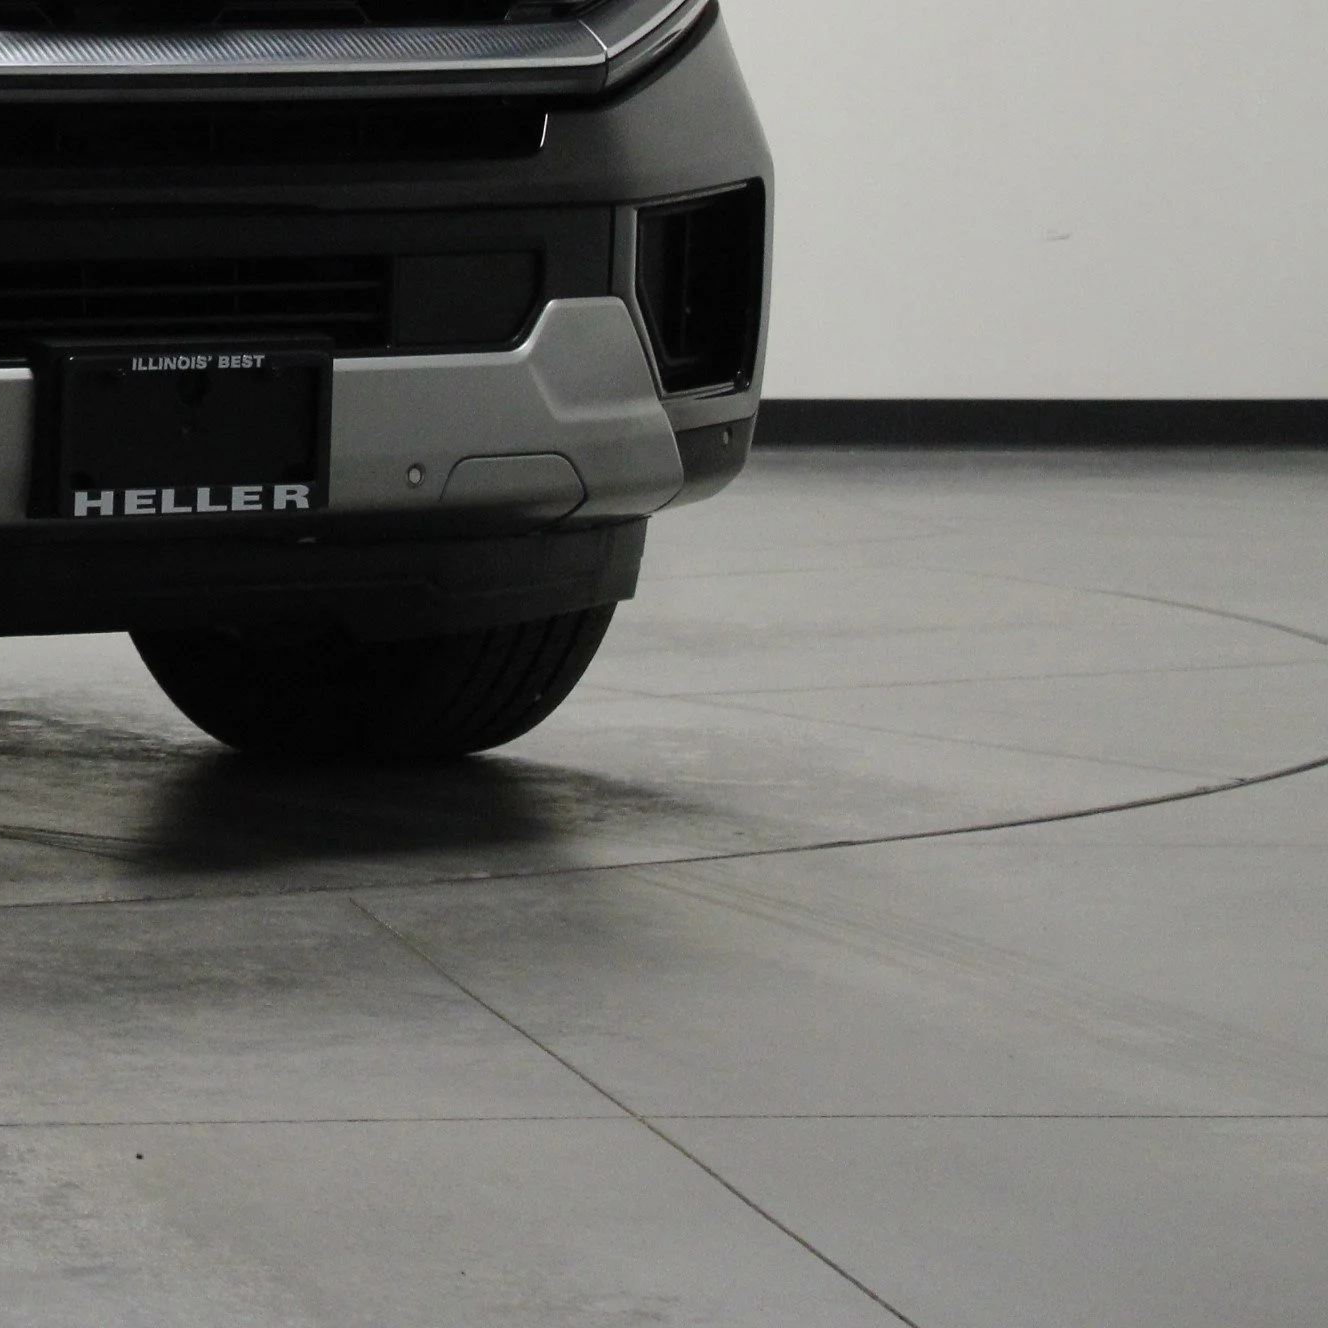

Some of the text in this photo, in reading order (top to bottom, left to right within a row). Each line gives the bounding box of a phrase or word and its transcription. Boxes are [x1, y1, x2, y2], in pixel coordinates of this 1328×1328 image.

[132, 354, 265, 371] ILLINOIS' BEST
[73, 484, 310, 517] HELLER
